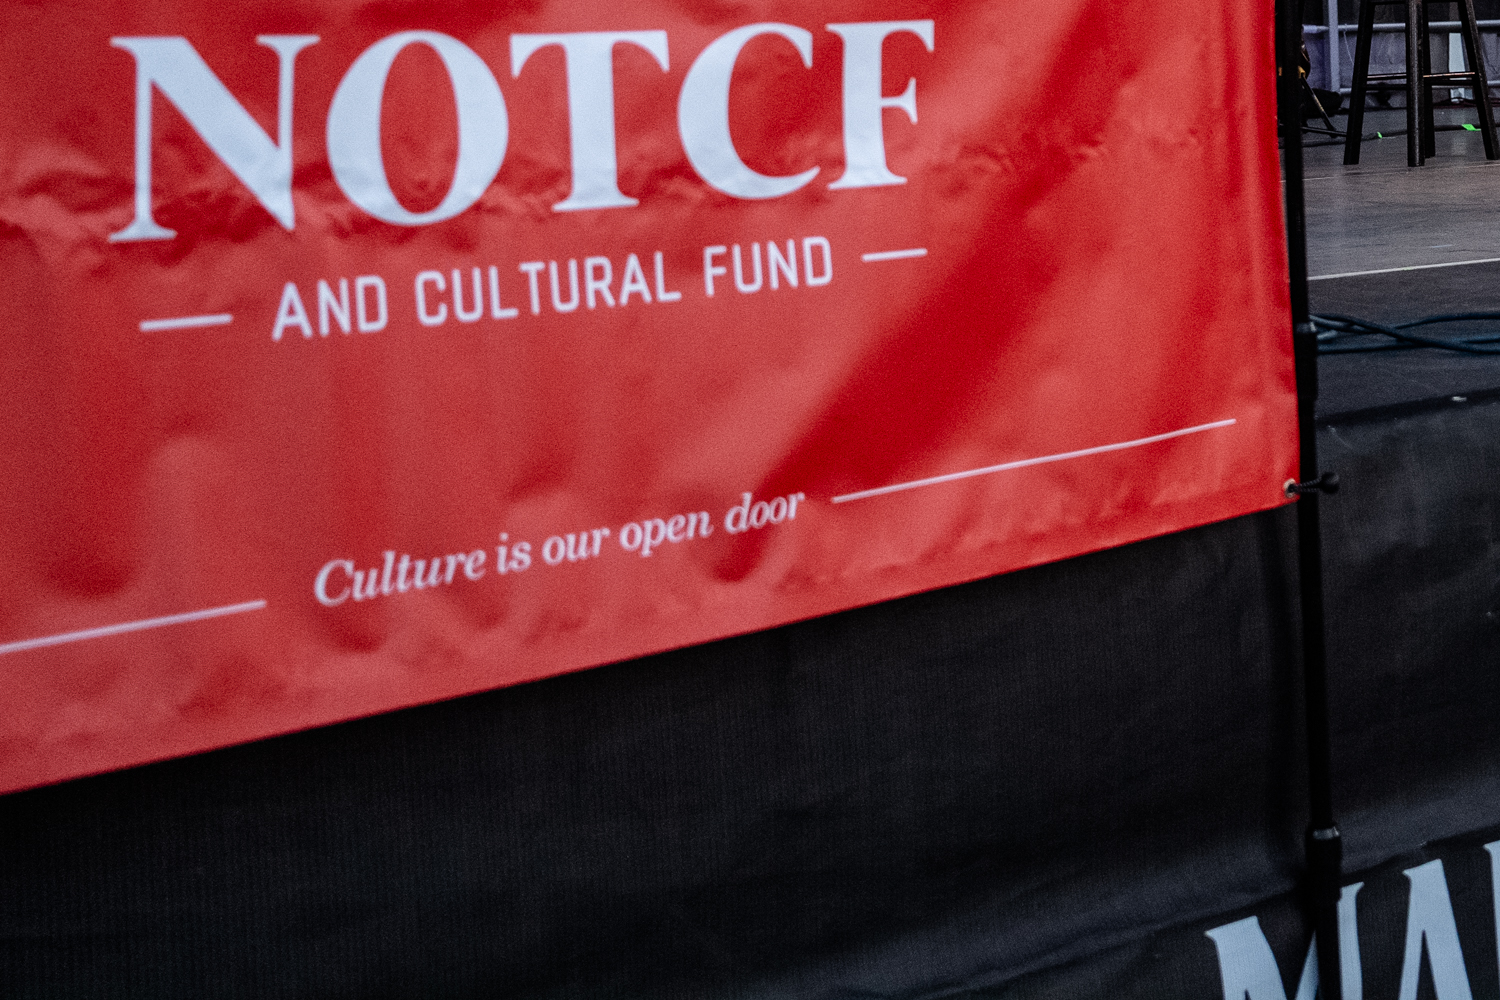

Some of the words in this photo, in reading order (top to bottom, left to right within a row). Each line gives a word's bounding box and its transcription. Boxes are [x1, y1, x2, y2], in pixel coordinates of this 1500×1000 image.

[107, 18, 937, 244] NOTCF
[271, 275, 388, 342] AND
[414, 251, 682, 327] CULTURAL
[703, 235, 834, 297] FUND
[313, 549, 487, 607] Culture
[496, 533, 532, 575] is
[541, 525, 611, 566] our
[618, 508, 714, 558] open
[723, 491, 806, 534] door
